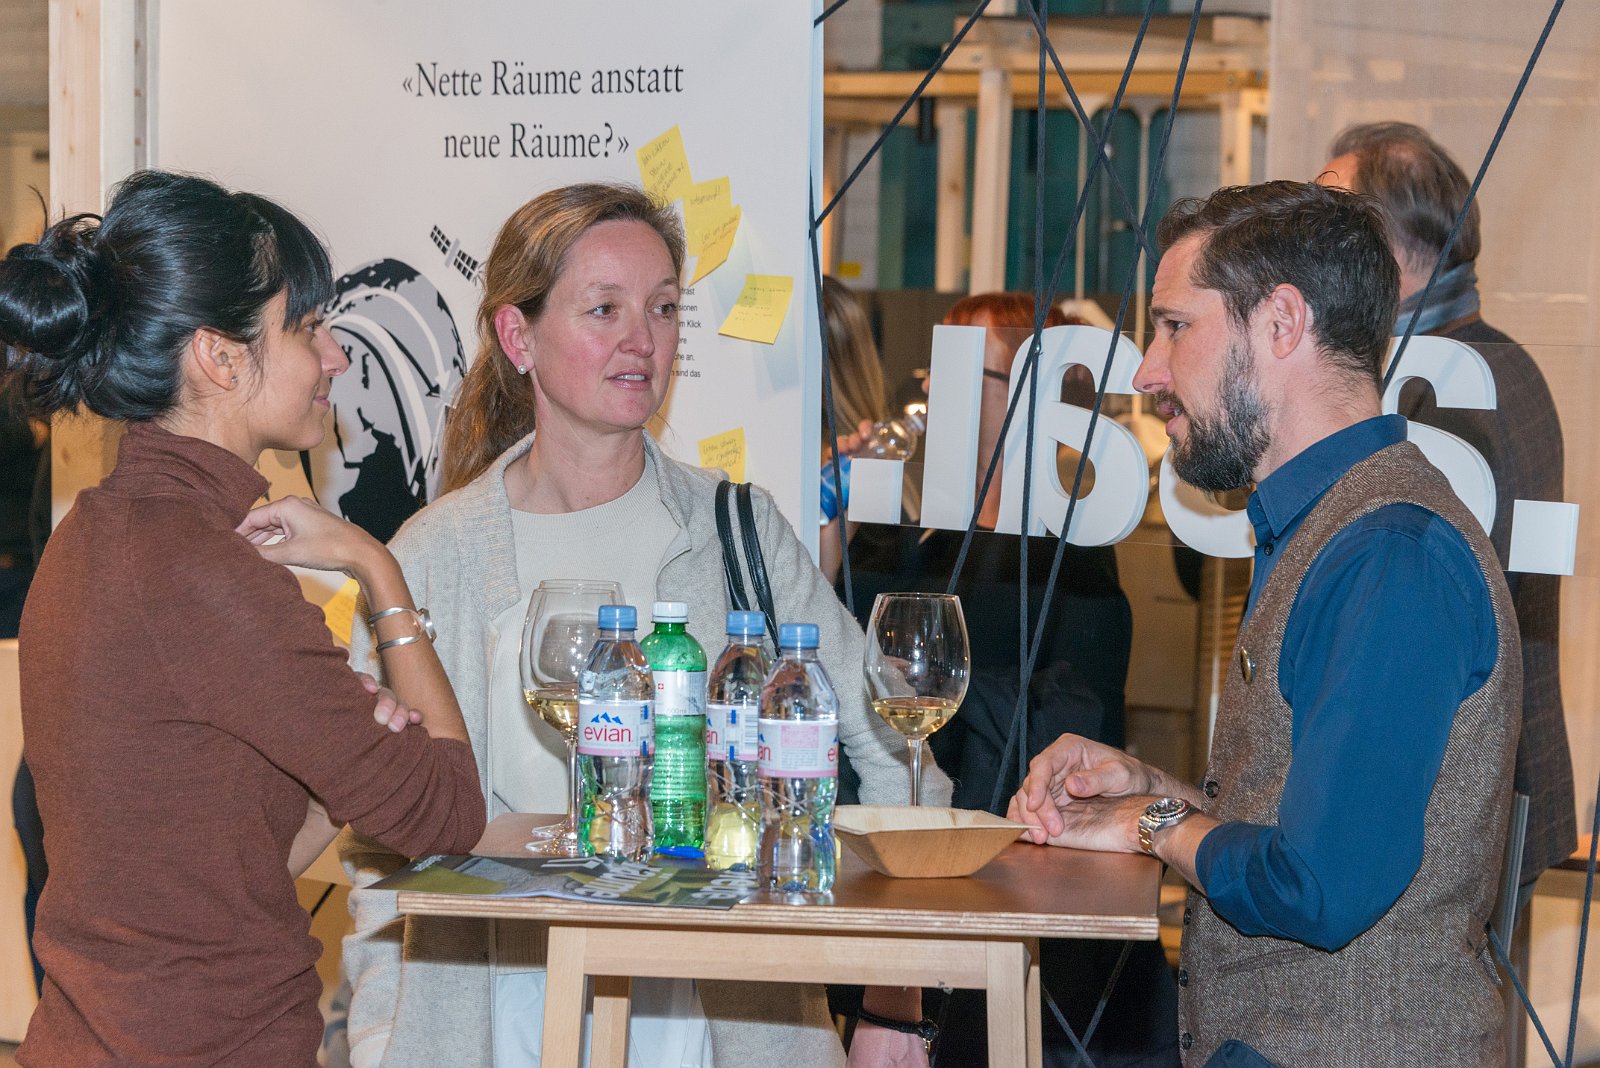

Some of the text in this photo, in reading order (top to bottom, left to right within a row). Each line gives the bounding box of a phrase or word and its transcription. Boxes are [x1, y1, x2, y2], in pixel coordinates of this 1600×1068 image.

[403, 61, 683, 96] «Nette Räume anstatt
[445, 123, 629, 158] neue Räume?»
[687, 319, 702, 328] Klick
[690, 369, 701, 378] das
[583, 724, 632, 743] evian
